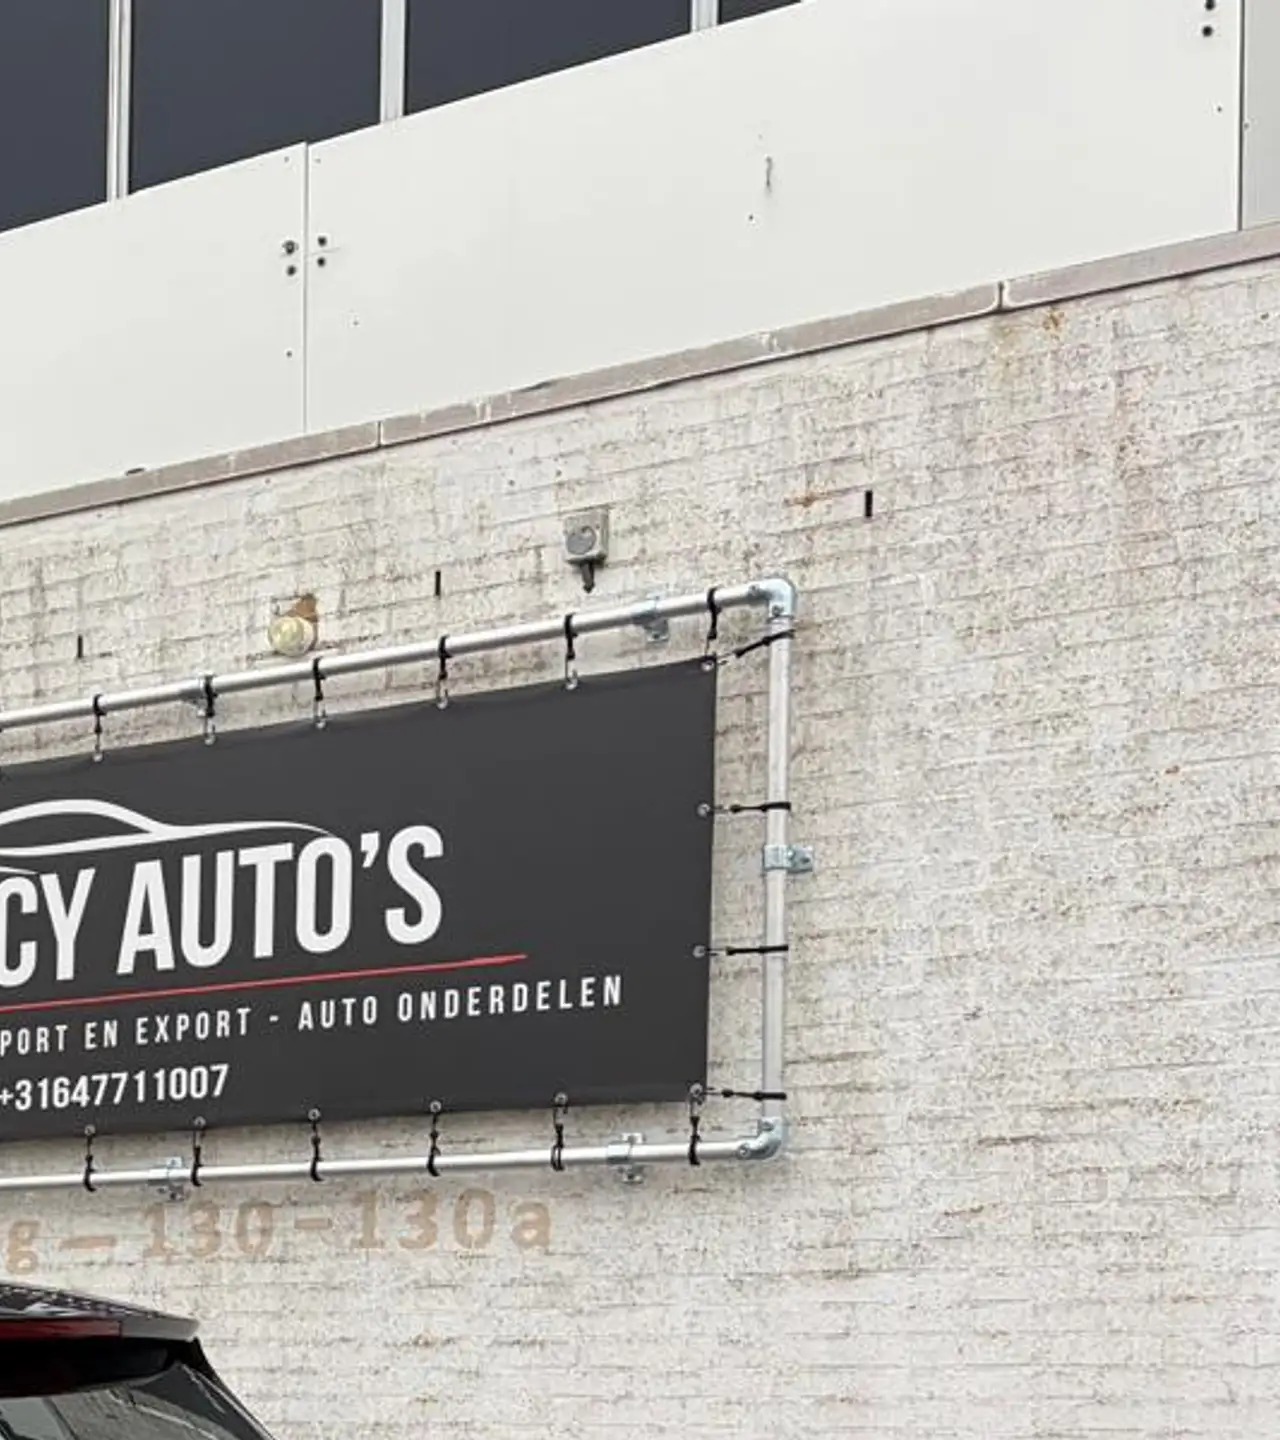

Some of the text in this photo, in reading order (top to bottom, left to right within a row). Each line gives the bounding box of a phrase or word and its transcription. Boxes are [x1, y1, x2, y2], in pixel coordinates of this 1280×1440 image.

[116, 825, 444, 981] AUTO'S
[84, 1019, 118, 1050] EN
[136, 1007, 251, 1045] EXPORT
[298, 995, 377, 1031] AUTO
[397, 975, 621, 1022] ONDERDELEN
